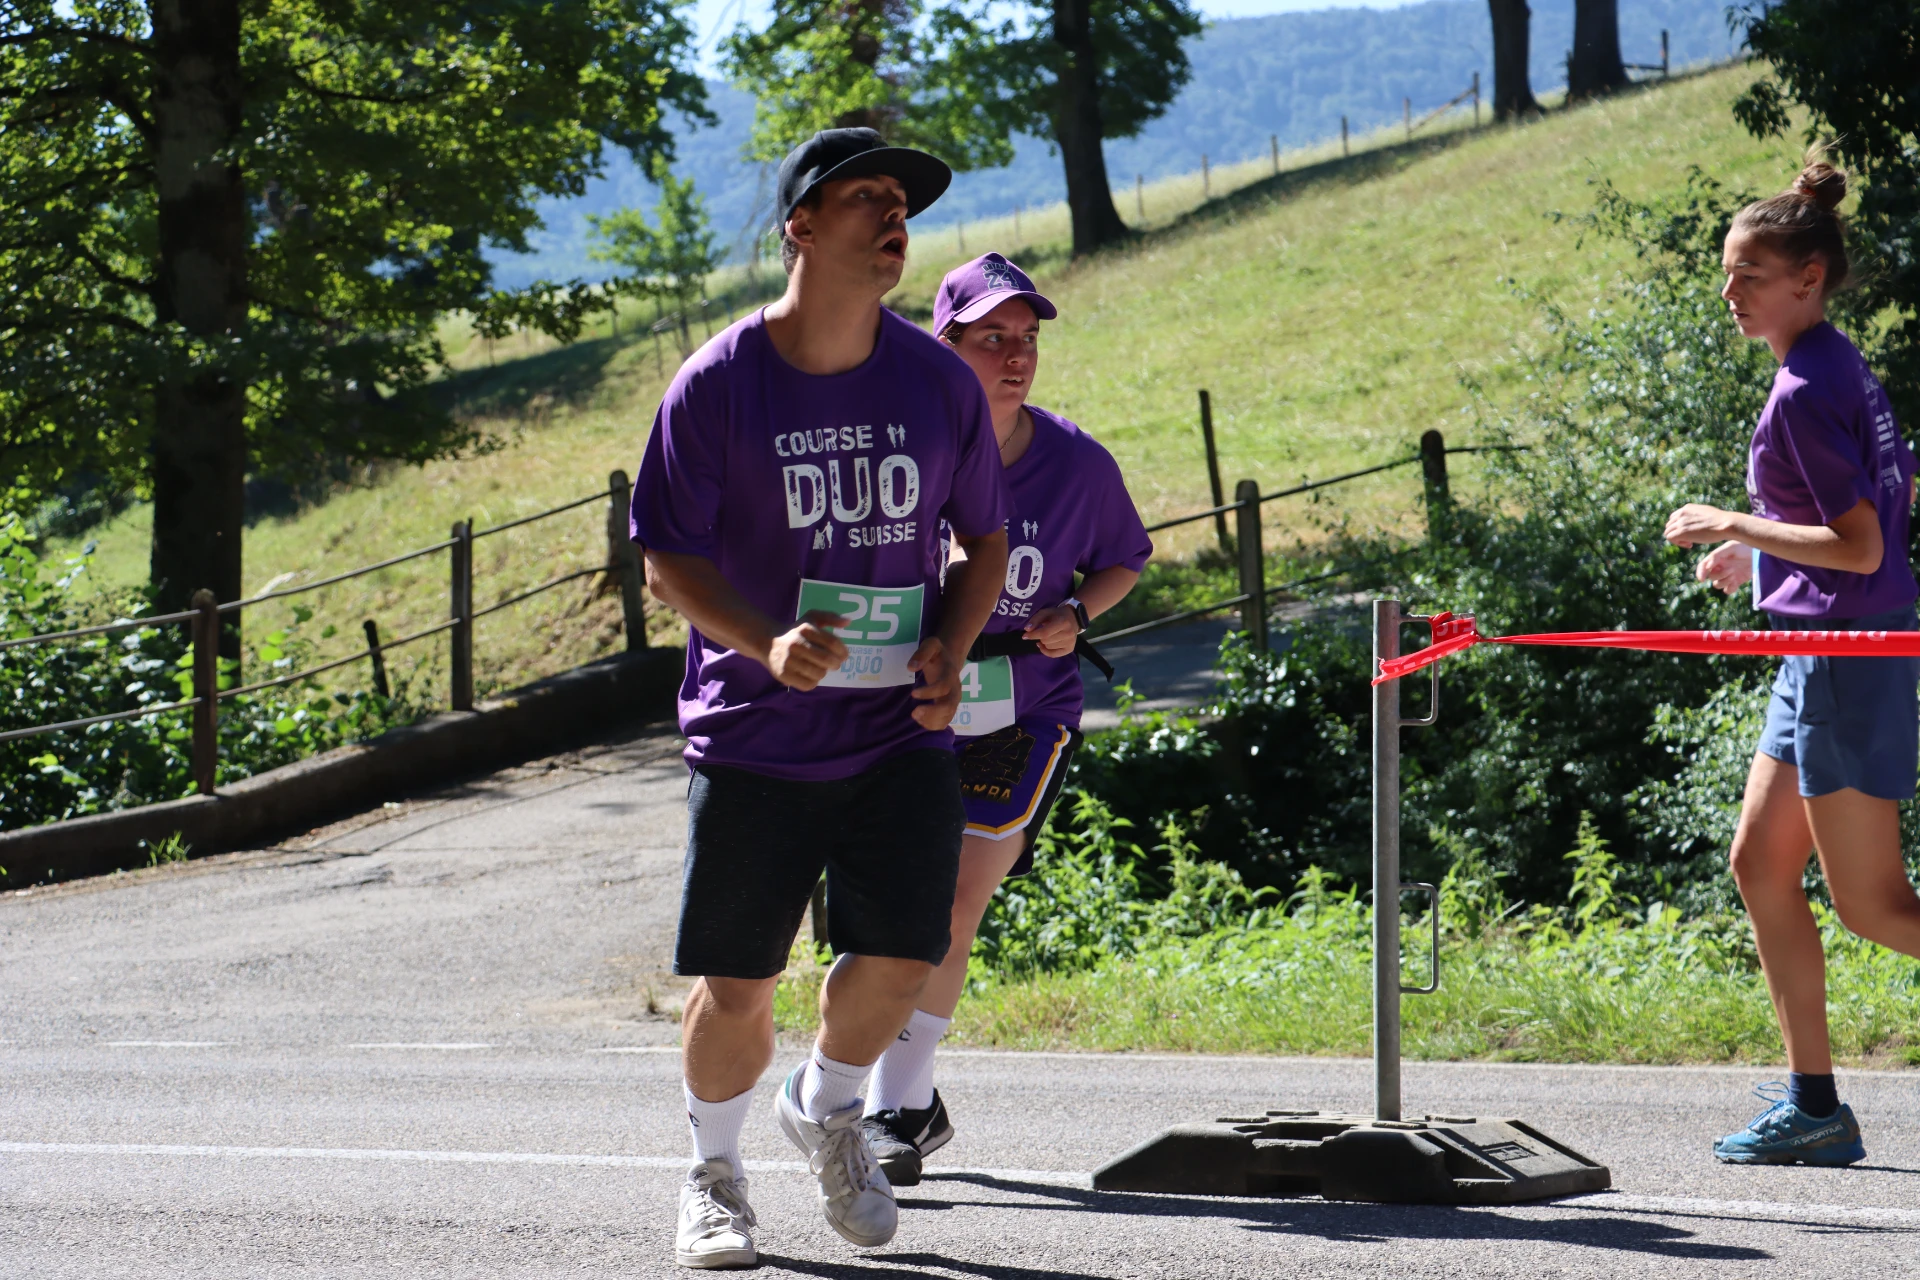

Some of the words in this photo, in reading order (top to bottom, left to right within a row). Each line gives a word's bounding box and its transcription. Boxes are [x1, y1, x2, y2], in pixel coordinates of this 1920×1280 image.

[983, 271, 1020, 290] 24
[774, 425, 874, 457] COURSE
[782, 454, 920, 529] DUO
[848, 522, 917, 548] SUISSE
[1005, 545, 1044, 600] O
[832, 592, 902, 640] 25
[847, 646, 873, 655] OURSE
